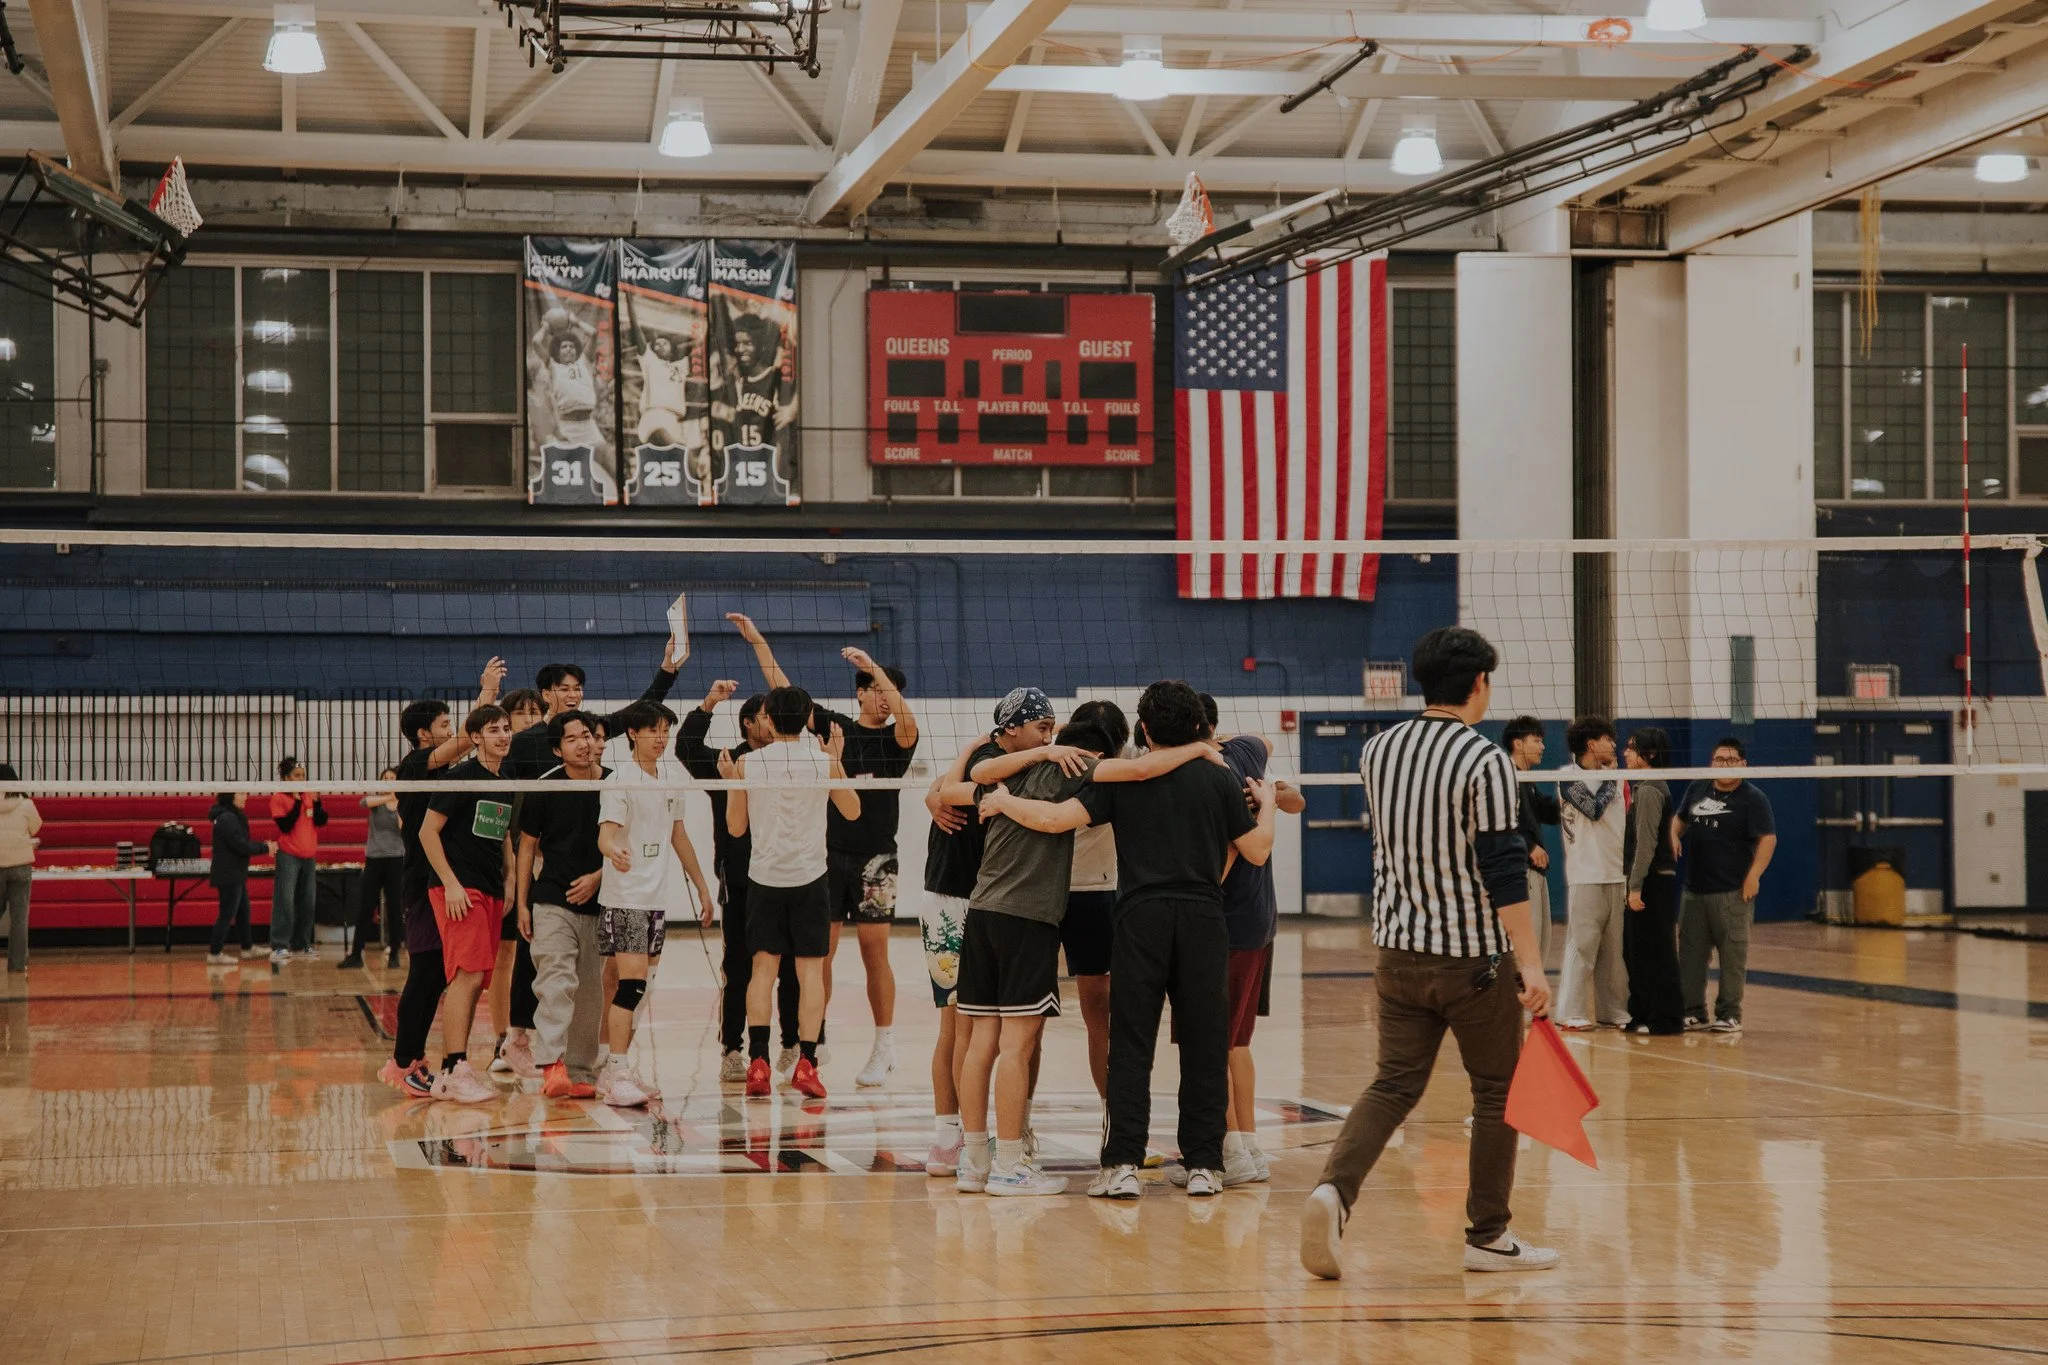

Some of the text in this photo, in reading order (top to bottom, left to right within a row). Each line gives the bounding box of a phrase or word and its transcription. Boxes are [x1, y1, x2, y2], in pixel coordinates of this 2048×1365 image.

[531, 255, 569, 266] ATHEA
[714, 257, 748, 268] DEBBIE
[531, 265, 583, 279] GWYN
[624, 267, 697, 282] MARQUIS
[714, 268, 772, 281] MASON
[886, 337, 950, 355] QUEENS
[1079, 340, 1132, 357] GUEST
[992, 348, 1033, 361] PERIOD
[884, 400, 920, 412] FOULS
[934, 400, 964, 413] T.O.L.
[978, 401, 1051, 413] PLAYER FOUL
[1063, 402, 1094, 414] T.O.L.
[1104, 402, 1140, 414] FOULS
[741, 424, 762, 446] 15
[885, 448, 921, 460] SCORE
[993, 449, 1032, 461] MATCH
[1105, 449, 1141, 462] SCORE
[551, 460, 584, 486] 31
[644, 461, 681, 487] 25
[735, 461, 767, 487] 15
[478, 814, 494, 824] New
[1694, 816, 1719, 828] AIR
